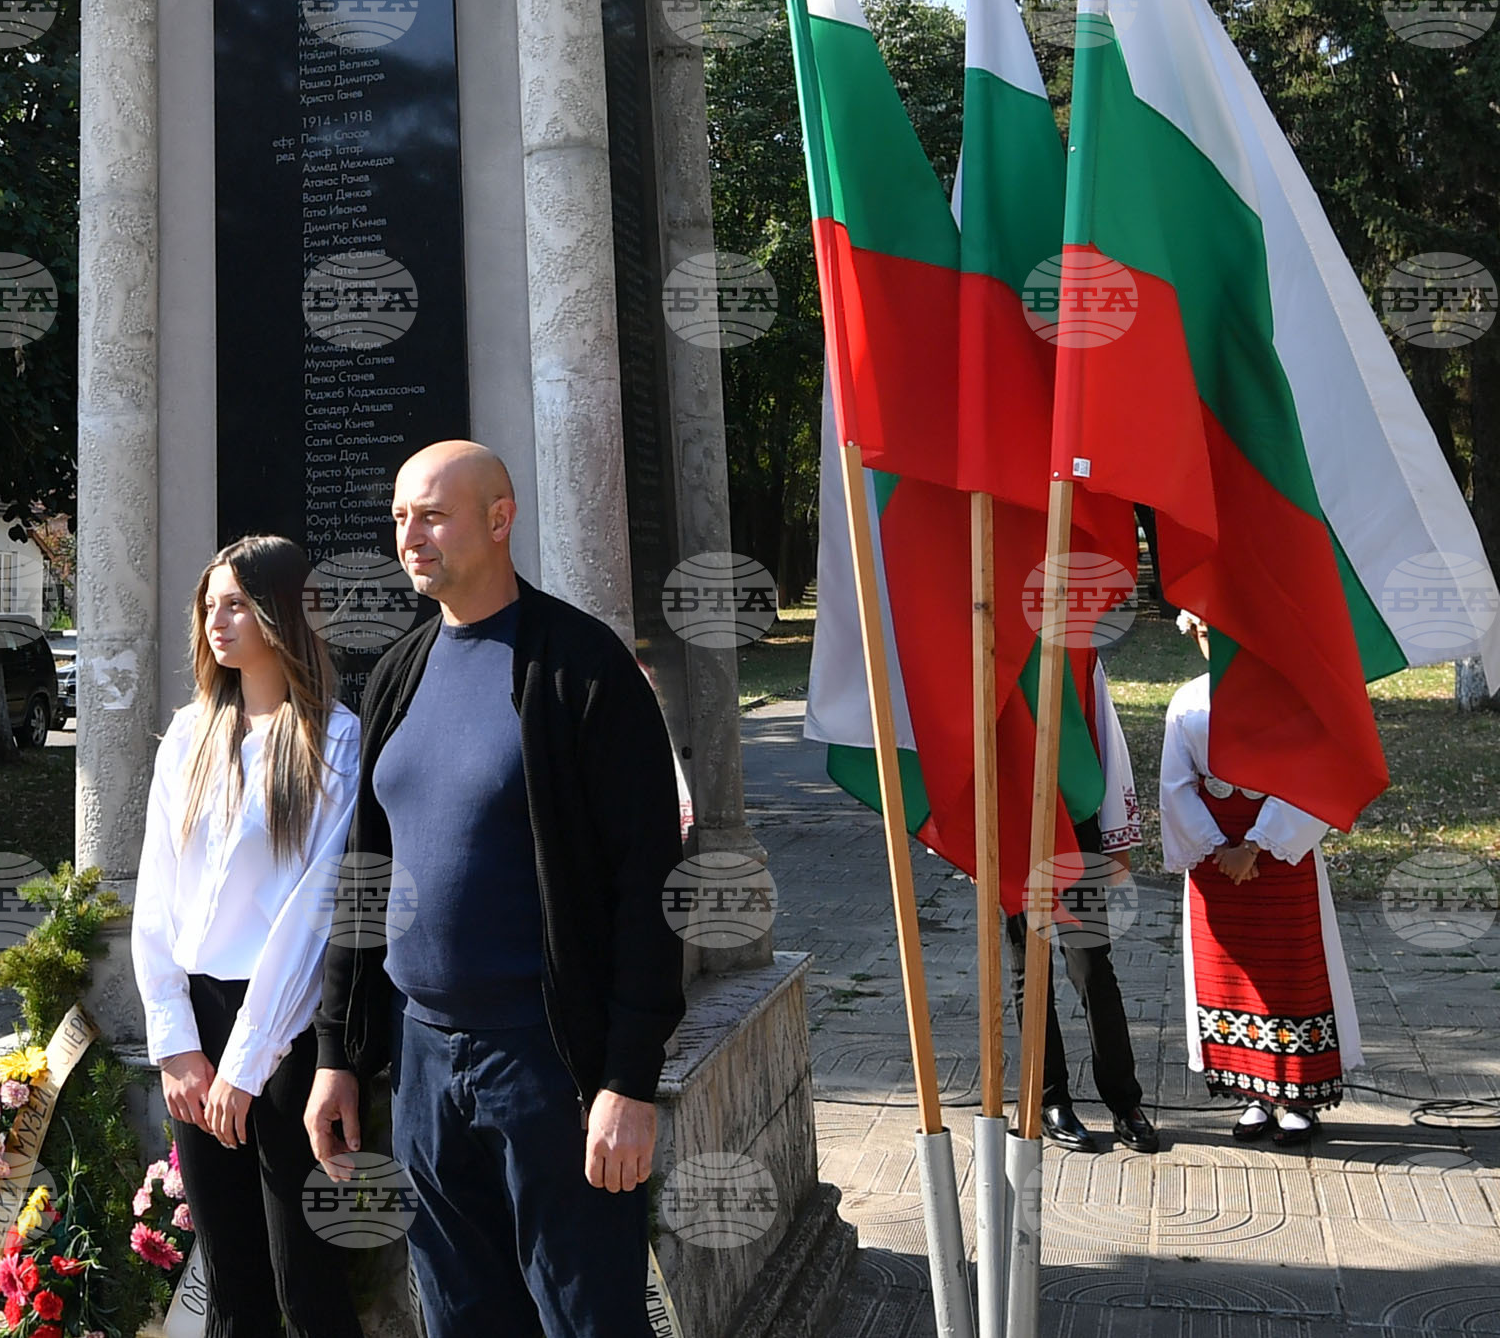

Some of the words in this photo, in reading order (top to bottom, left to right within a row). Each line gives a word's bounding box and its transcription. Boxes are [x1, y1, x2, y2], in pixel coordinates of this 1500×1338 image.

[299, 63, 337, 76] Никола
[339, 58, 380, 71] Великов
[299, 77, 332, 90] Рашко
[333, 72, 385, 87] Димитров
[299, 92, 334, 107] Христо
[336, 89, 364, 101] Ганев
[302, 115, 331, 129] 1914
[343, 109, 373, 124] 1918
[276, 152, 296, 164] ред
[301, 146, 332, 160] Ариф
[334, 144, 364, 157] Татар
[301, 162, 338, 174] Ахмед
[340, 156, 396, 170] Мехмедов
[302, 176, 340, 189] Атанас
[302, 192, 333, 204] Васил
[329, 203, 368, 216] Иванов
[302, 220, 349, 235] Димитър
[304, 342, 349, 354] Мехмед
[304, 357, 355, 371] Мухарем
[356, 354, 396, 367] Салиев
[338, 371, 376, 383] Станев
[304, 388, 345, 400] Реджеб
[347, 385, 427, 398] Коджахасанов
[304, 403, 350, 417] Скендер
[304, 419, 342, 431] Стойчо
[344, 417, 376, 430] Кънев
[304, 435, 333, 447] Сали
[335, 432, 405, 446] Сюлейманов
[304, 450, 337, 463] Хасан
[339, 449, 370, 463] Дауд
[305, 465, 342, 481] Христо
[344, 464, 386, 479] Христов
[305, 482, 342, 497] Христо
[306, 513, 342, 529] Юсуф
[306, 529, 332, 545] Якуб
[333, 528, 378, 542] Хасанов
[307, 547, 335, 561] 1941
[350, 545, 382, 560] 1945
